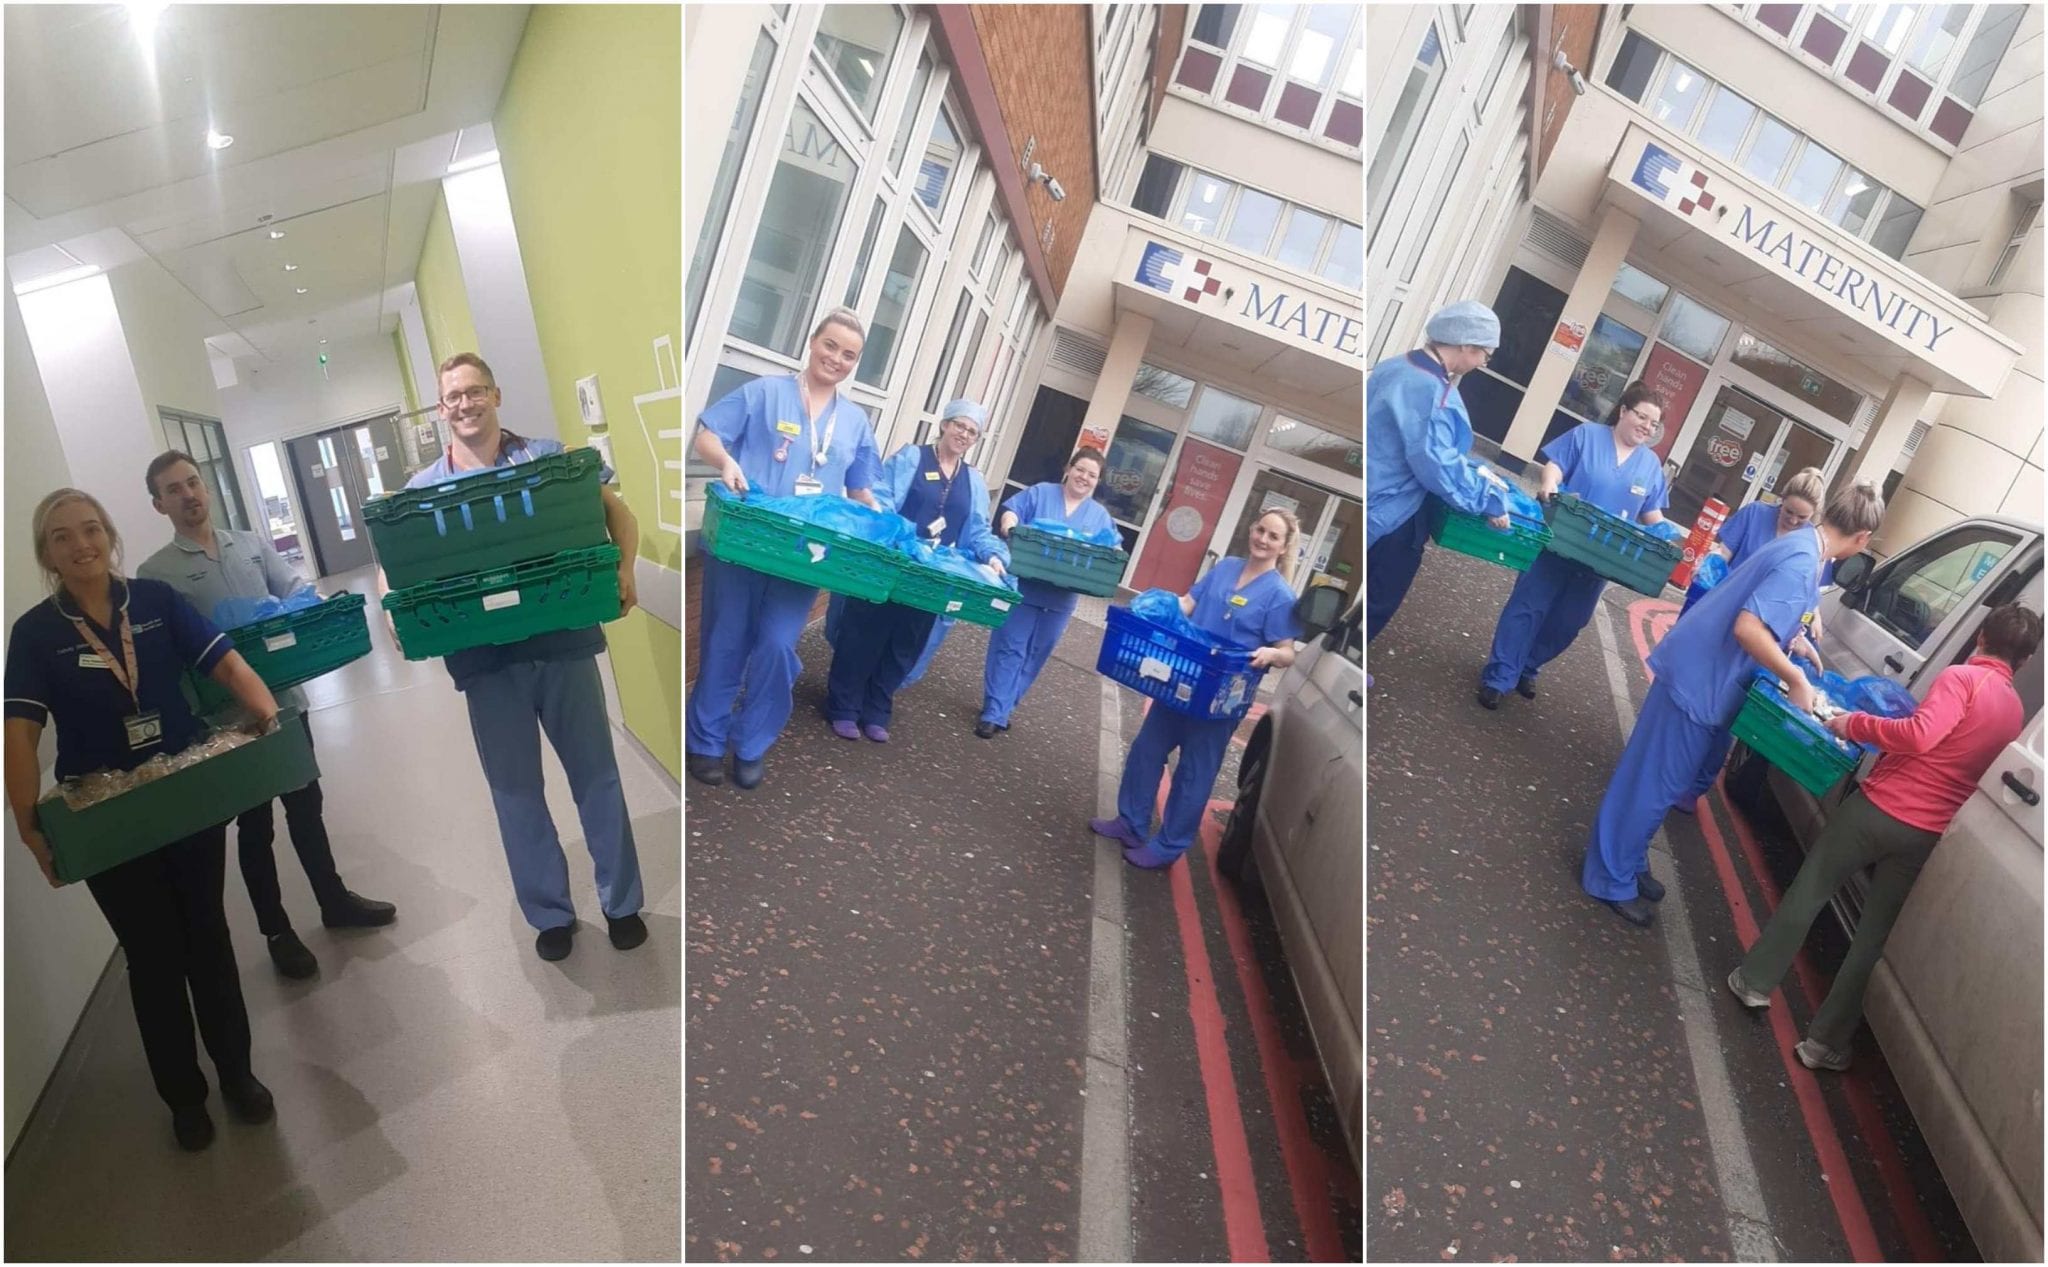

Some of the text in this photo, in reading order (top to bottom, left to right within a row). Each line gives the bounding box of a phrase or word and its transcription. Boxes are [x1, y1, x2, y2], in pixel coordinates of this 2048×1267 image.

[1730, 205, 1954, 352] MATERNITY
[1240, 283, 1363, 358] MATE
[1575, 363, 1607, 385] free
[1656, 370, 1684, 391] hands
[1663, 361, 1687, 380] Clean
[1709, 438, 1740, 460] free
[1190, 464, 1218, 481] hands
[1196, 454, 1221, 470] Clean
[1106, 468, 1140, 486] free
